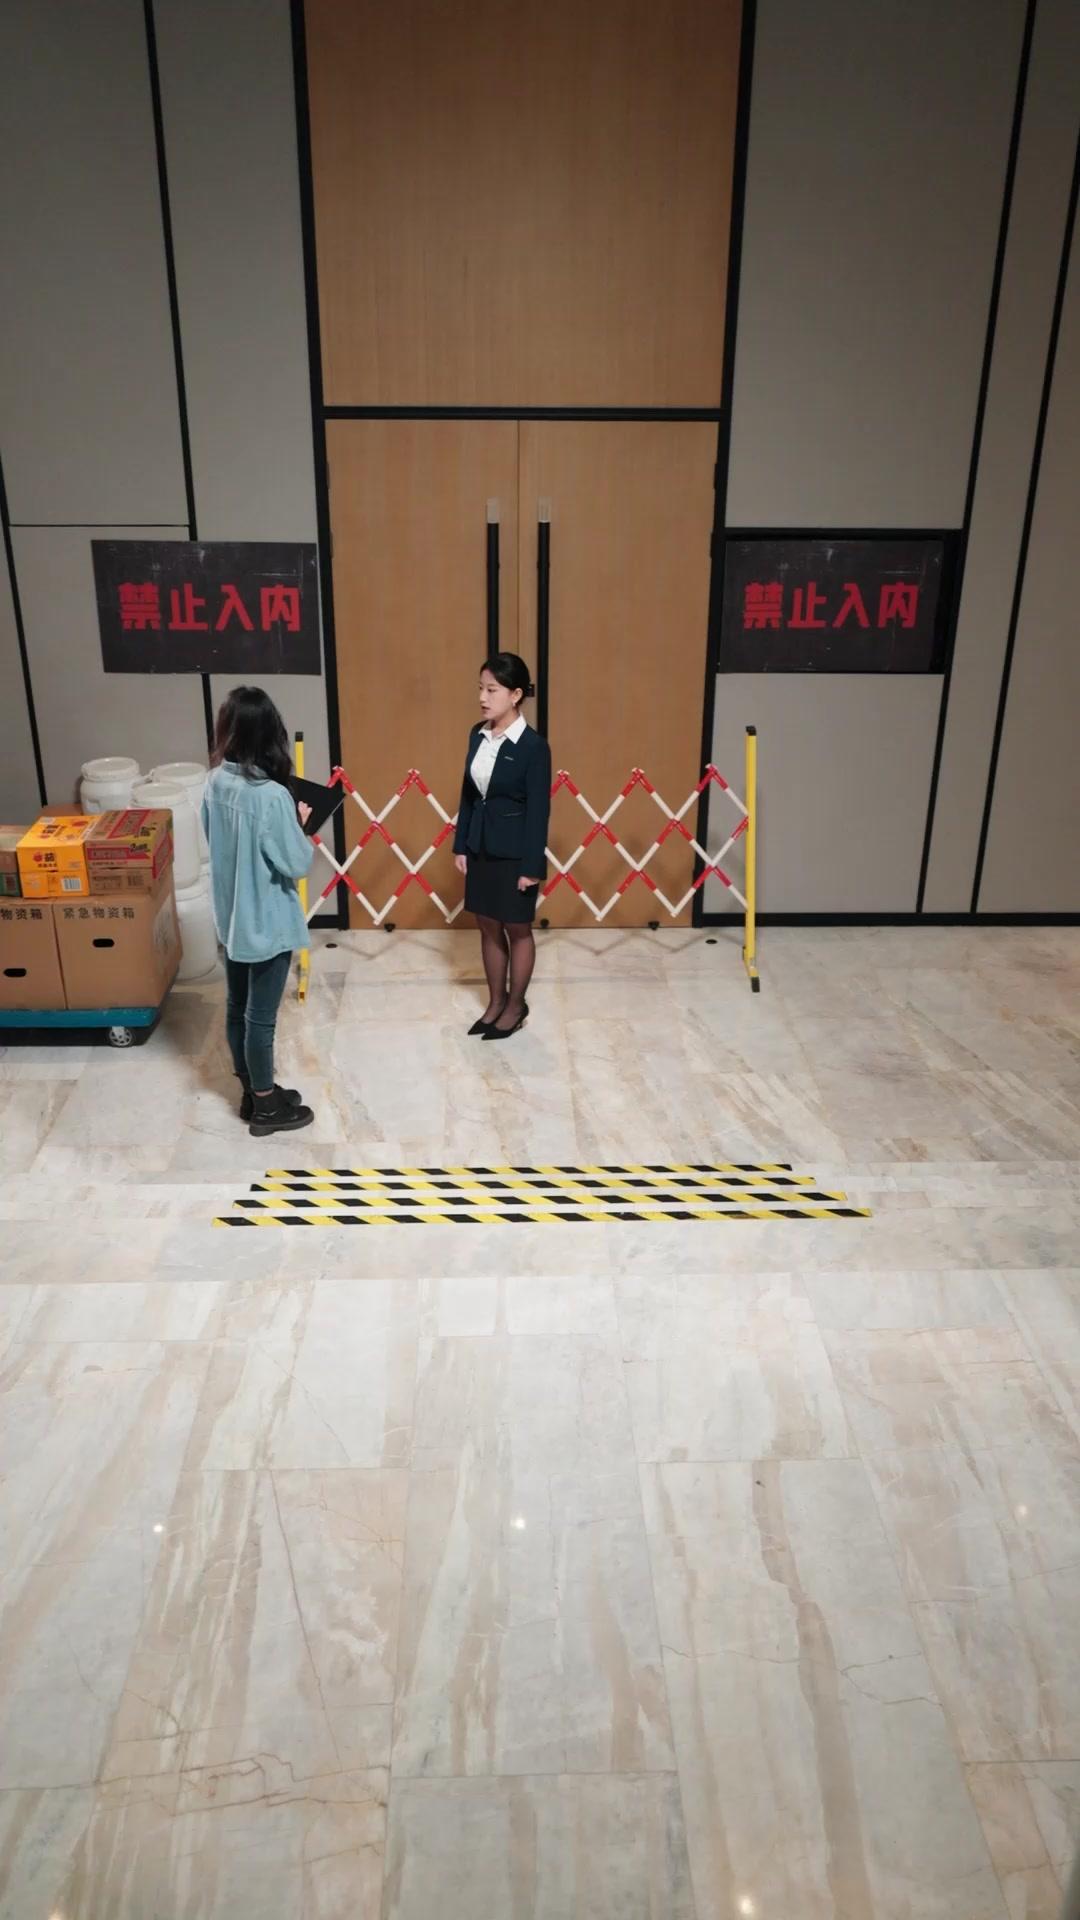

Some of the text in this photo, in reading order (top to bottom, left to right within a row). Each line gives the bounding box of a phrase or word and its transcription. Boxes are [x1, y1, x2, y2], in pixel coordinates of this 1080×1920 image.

[119, 582, 301, 632] 禁止入内
[743, 581, 919, 630] 禁止入内
[0, 907, 43, 920] 物资箱
[63, 907, 135, 920] 紧急物资箱
